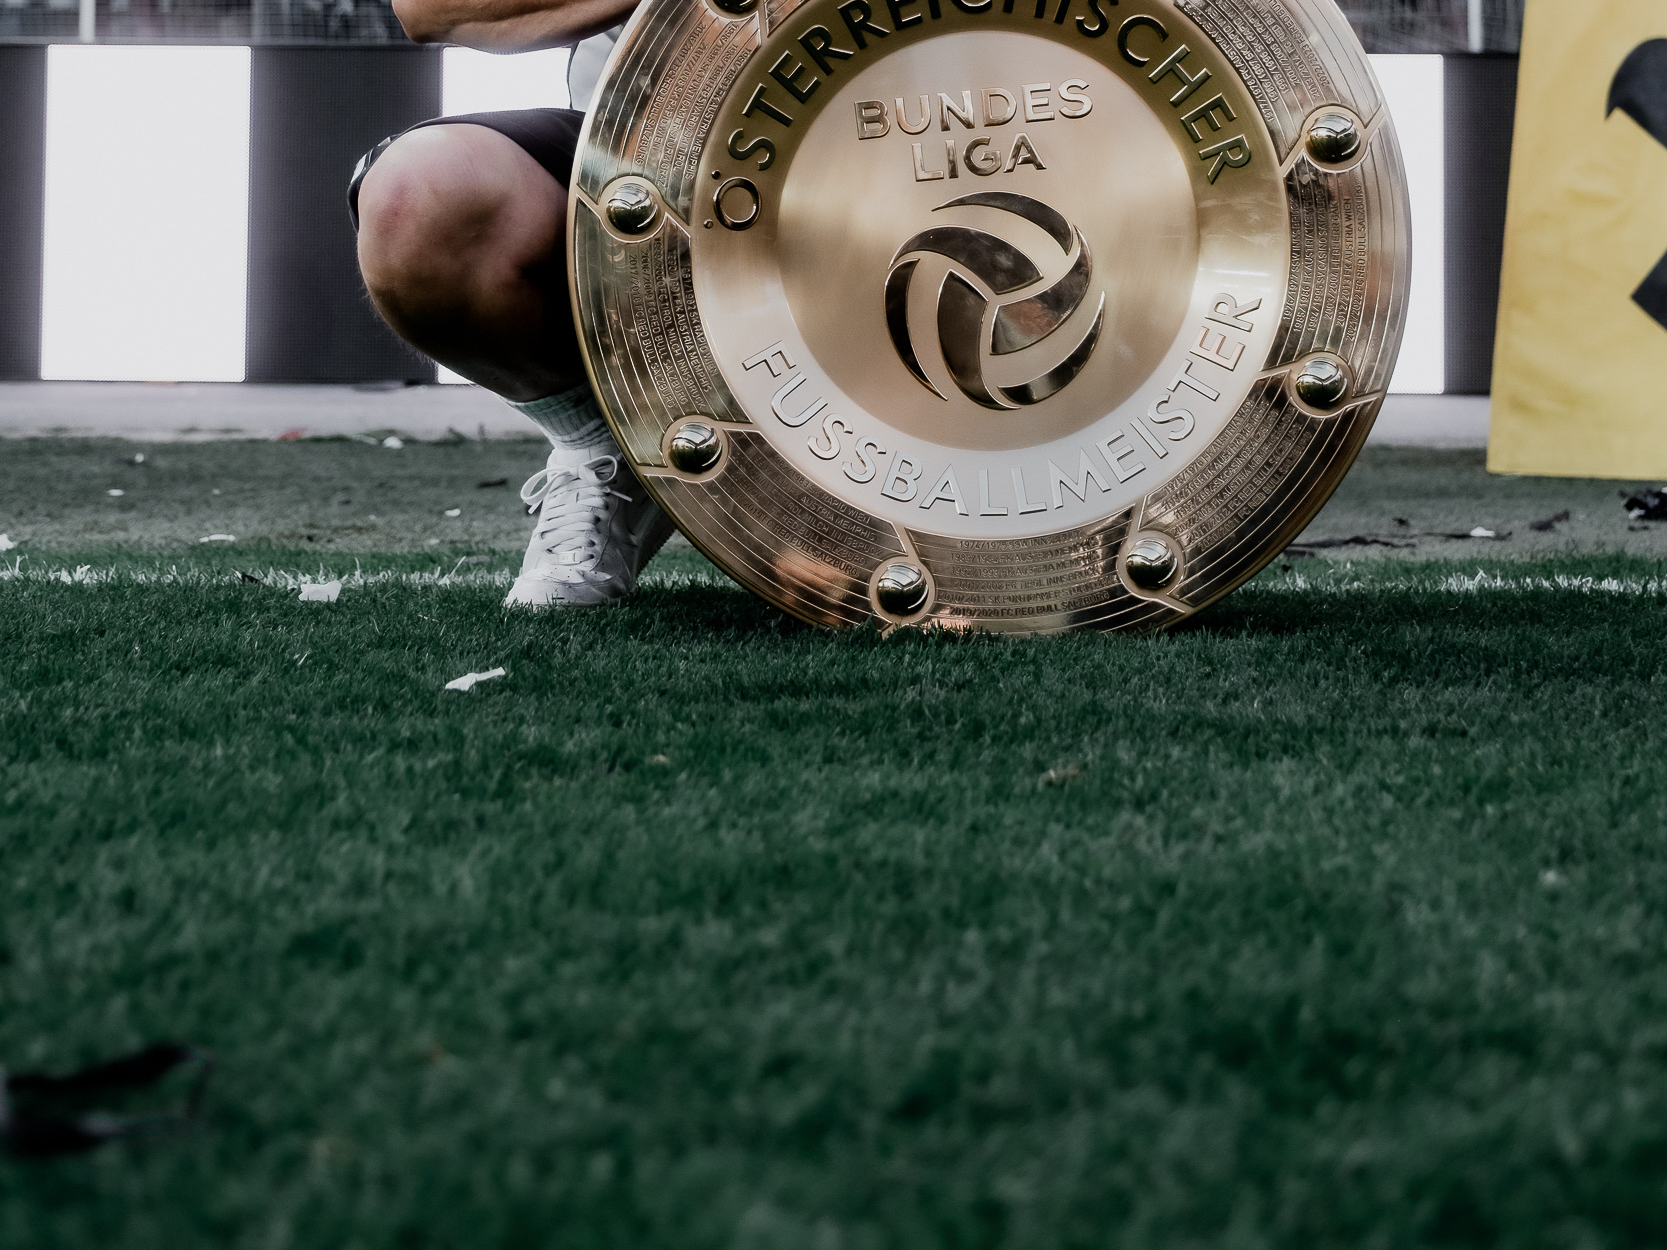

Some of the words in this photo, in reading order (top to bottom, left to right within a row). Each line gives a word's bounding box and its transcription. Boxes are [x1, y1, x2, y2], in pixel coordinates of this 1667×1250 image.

[1203, 3, 1228, 28] WIEN
[1232, 15, 1257, 42] RAPID
[1242, 6, 1268, 35] RAPID
[1280, 13, 1298, 34] RED
[673, 19, 707, 64] 2016/2017
[1214, 32, 1245, 69] AUSTRIA
[1222, 23, 1247, 50] RAPID
[1251, 38, 1265, 53] SK
[1261, 30, 1276, 45] SK
[1291, 29, 1306, 46] FC
[719, 45, 752, 88] 1980/1981
[1240, 45, 1255, 61] SK
[1268, 41, 1301, 87] 2004/2005
[1299, 42, 1329, 88] 2022/2023
[695, 60, 710, 76] SK
[1238, 64, 1253, 80] FK
[1247, 56, 1280, 103] 1986/1987
[1259, 49, 1290, 95] 1995/1996
[657, 73, 674, 95] RED
[669, 83, 683, 99] SK
[699, 83, 713, 98] FC
[647, 93, 665, 119] BULL
[671, 73, 703, 130] PUNTIGAMER
[853, 77, 1094, 140] BUNDES
[1246, 76, 1275, 123] 1977/1978
[696, 99, 719, 138] AUSTRIA
[634, 117, 656, 165] SALZBURG
[673, 145, 688, 172] TIROL
[684, 136, 704, 180] MEMPHIS
[910, 131, 1048, 183] LIGA
[656, 161, 670, 187] GRAZ
[1342, 197, 1354, 223] WIEN
[1353, 183, 1367, 232] SALZBURG
[1317, 236, 1328, 270] CASINO
[1343, 223, 1354, 261] AUSTRIA
[1357, 233, 1367, 257] BULL
[626, 253, 642, 303] 2017/2018
[1315, 269, 1326, 284] SV
[1342, 261, 1353, 275] FK
[1355, 258, 1366, 278] RED
[656, 287, 667, 302] FC
[1280, 273, 1299, 322] 1976/1977
[1290, 252, 1301, 273] SSW
[1353, 277, 1365, 292] FC
[632, 303, 645, 319] FC
[658, 301, 673, 327] TIROL
[1291, 284, 1311, 333] 1985/1986
[1302, 270, 1313, 285] FK
[1305, 283, 1324, 333] 1994/1995
[1333, 276, 1352, 327] 2012/2013
[635, 317, 650, 338] RED
[647, 313, 661, 334] RED
[687, 309, 700, 325] SK
[1343, 292, 1363, 341] 2021/2022
[640, 337, 658, 363] BULL
[653, 334, 669, 359] BULL
[665, 327, 682, 356] MILCH
[674, 311, 695, 352] AUSTRIA
[686, 350, 714, 393] MEMPHIS
[691, 323, 710, 353] RAPID
[648, 360, 678, 409] SALZBURG
[675, 356, 708, 410] INNSBRUCK
[741, 291, 1263, 517] FUSSBALLMEISTER
